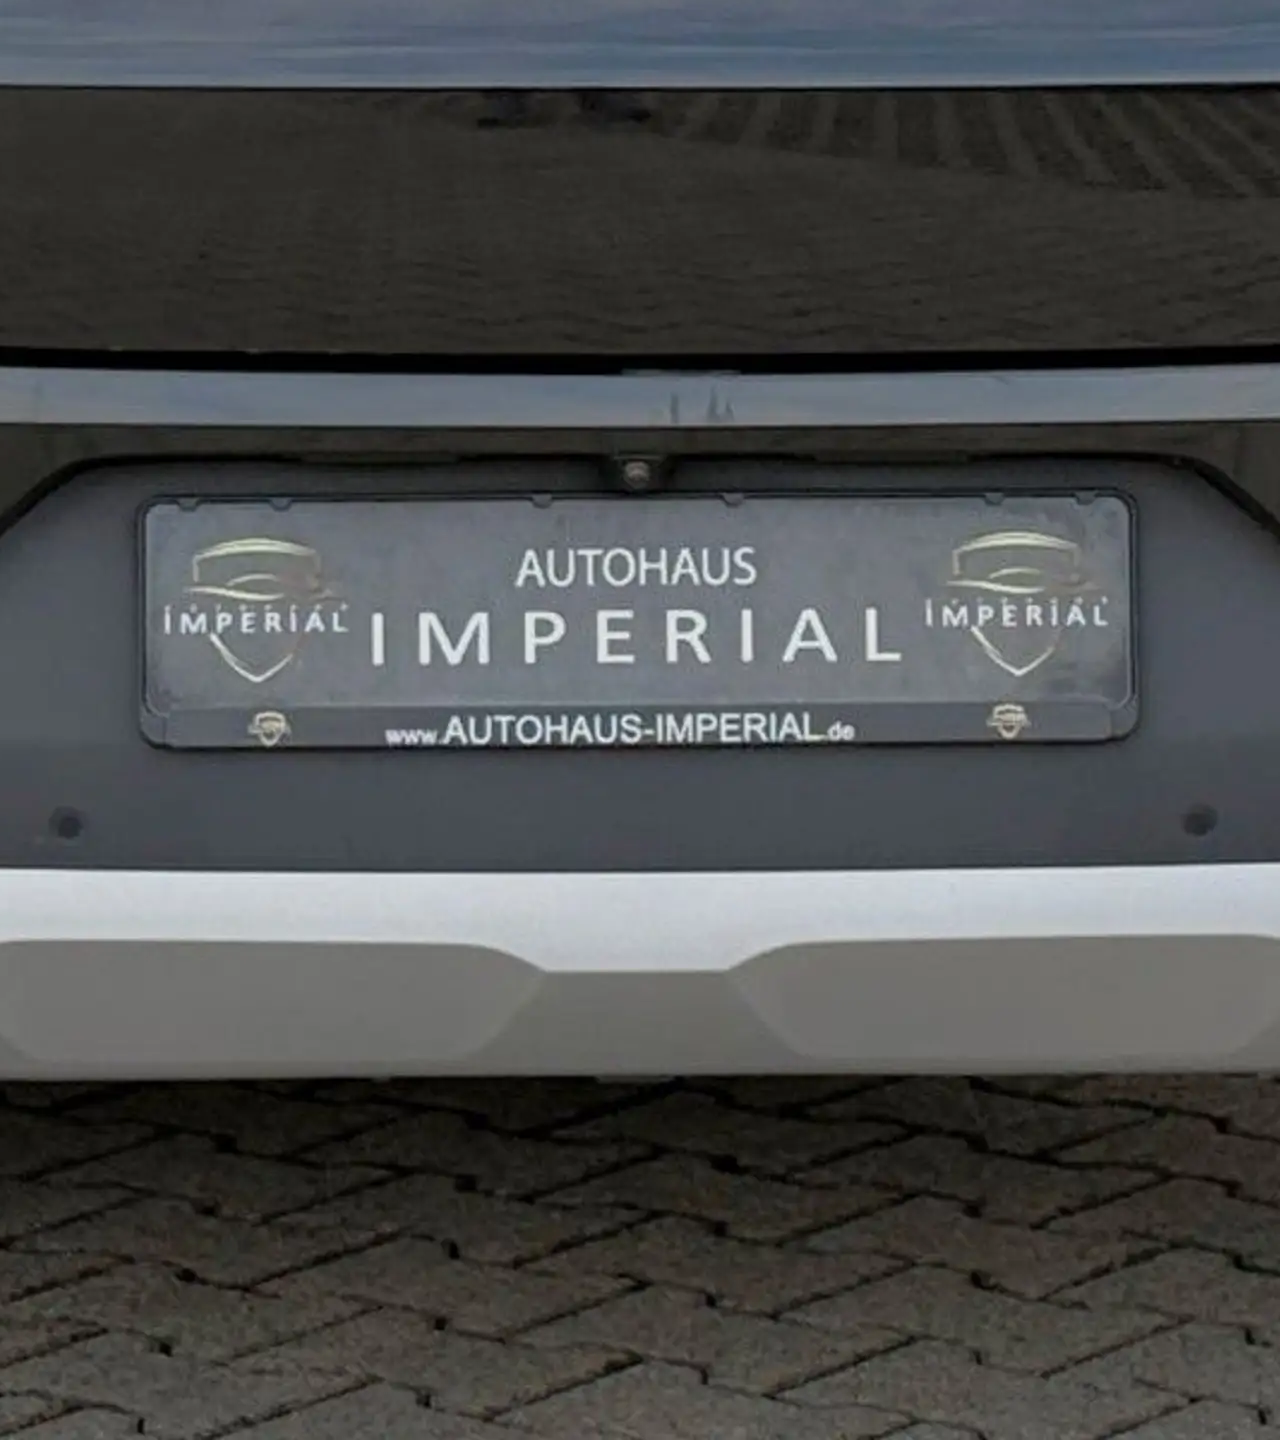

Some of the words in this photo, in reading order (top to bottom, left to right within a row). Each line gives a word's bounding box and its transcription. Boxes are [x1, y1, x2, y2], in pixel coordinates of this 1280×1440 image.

[516, 546, 758, 588] AUTOHAUS
[164, 606, 349, 635] IMPERIAL
[925, 599, 1109, 628] IMPERIAL
[371, 607, 903, 666] IMPERIAL
[385, 712, 855, 745] www.AUTOHAUS-IMPERIAL.de
